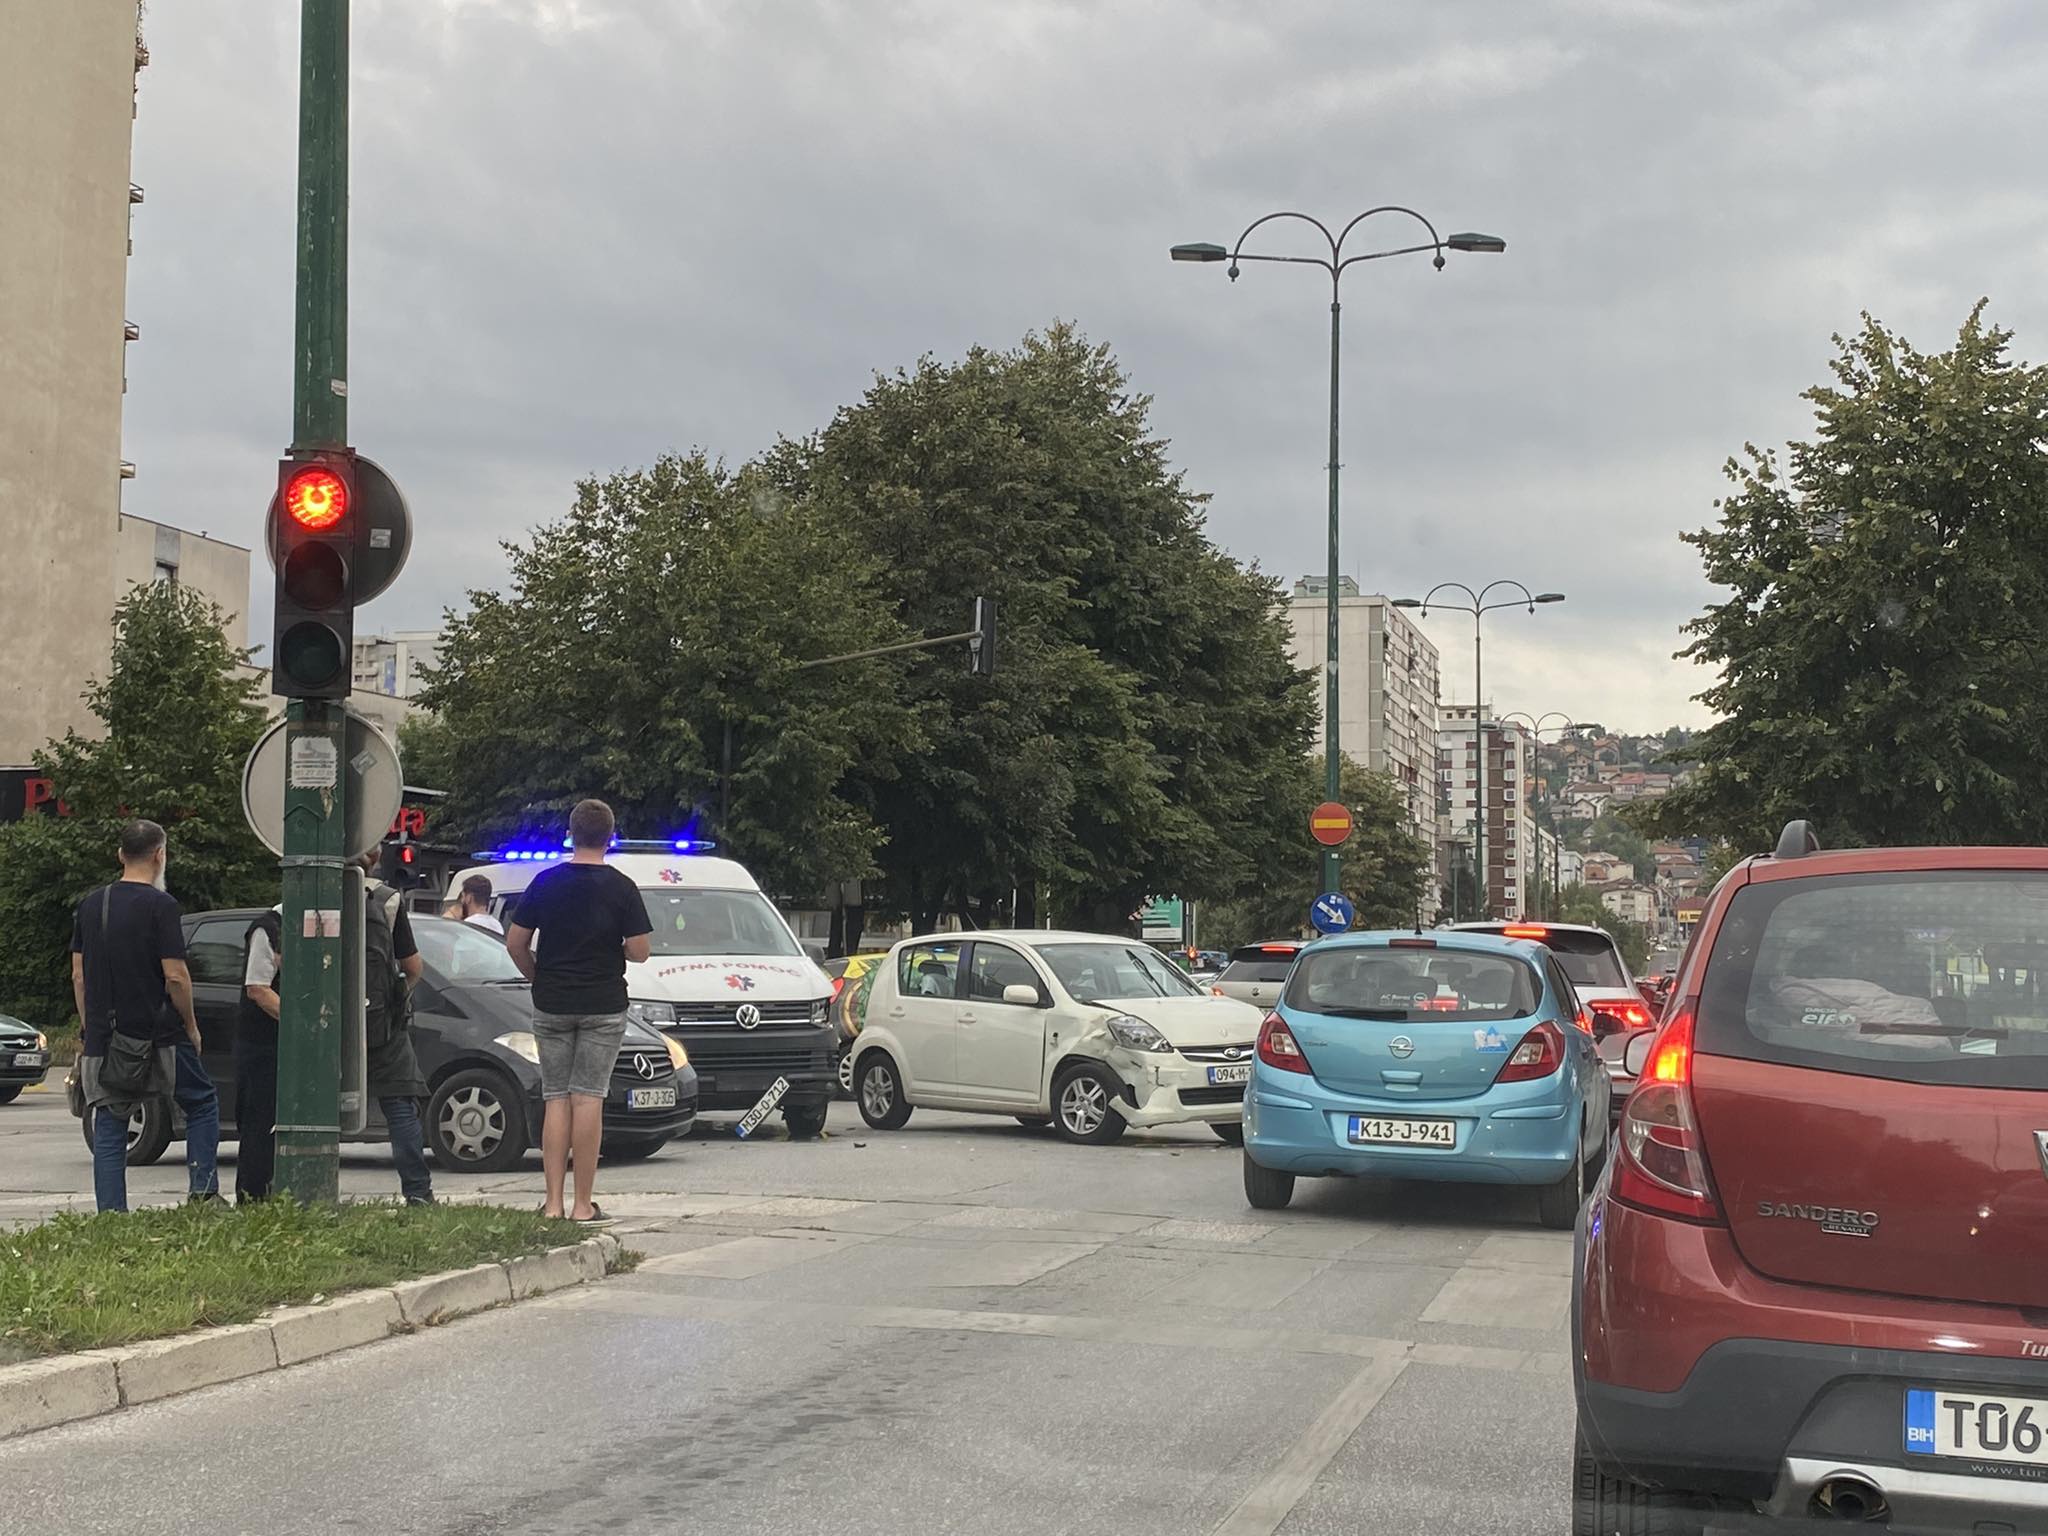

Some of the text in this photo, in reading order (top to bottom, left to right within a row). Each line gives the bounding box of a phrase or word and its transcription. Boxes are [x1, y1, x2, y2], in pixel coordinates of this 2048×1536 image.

[658, 963, 717, 978] HITNA
[1801, 1014, 1836, 1024] elf
[1216, 1067, 1251, 1081] 094-M-
[1360, 1120, 1451, 1141] K13-J-941
[1757, 1201, 1879, 1227] SANDERO
[1828, 1224, 1868, 1234] RENAULT
[1907, 1400, 2048, 1454] BIH T06
